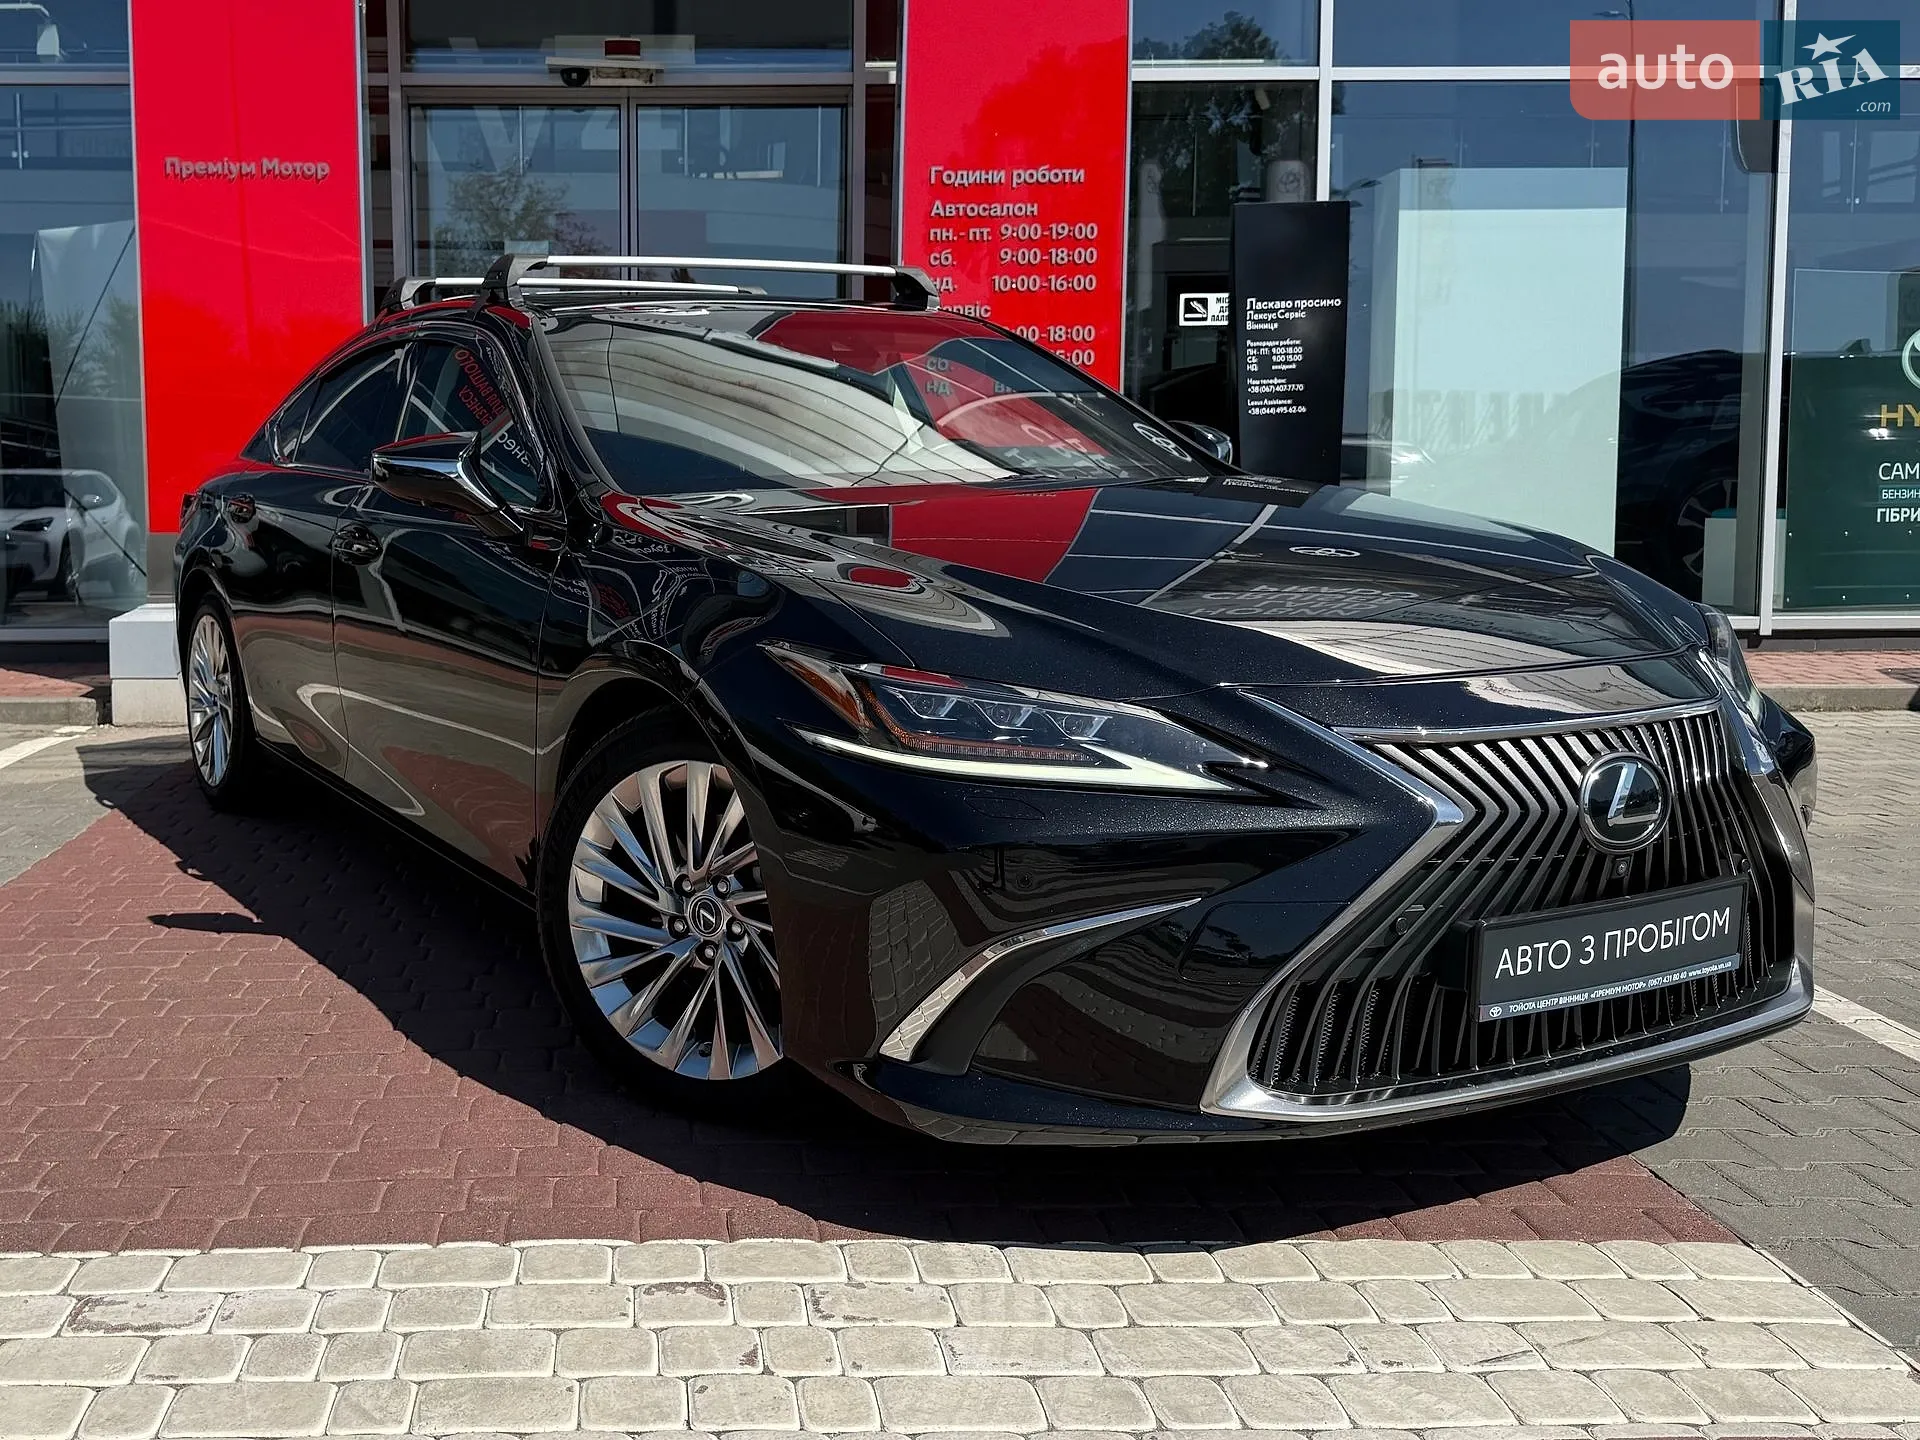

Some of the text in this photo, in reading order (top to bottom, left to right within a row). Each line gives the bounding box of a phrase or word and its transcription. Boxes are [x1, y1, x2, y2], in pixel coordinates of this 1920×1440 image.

[164, 157, 330, 180] Преміум Мотор
[929, 164, 1085, 188] Години роботи
[930, 200, 1038, 218] Автосалон
[1000, 223, 1098, 240] 9:00-19:00
[929, 248, 1097, 266] сб. 9:00-18:00
[992, 275, 1097, 292] 10:00-16:00
[1246, 298, 1342, 311] Ласкаво просимо
[1246, 309, 1306, 322] Лексус Сервіс
[1003, 325, 1096, 342] :00-18:00
[1246, 320, 1279, 332] Вінниця
[1494, 939, 1572, 980] АВТО
[1603, 906, 1731, 961] ПРОБІГОМ
[1508, 1002, 1537, 1014] ТОЙОТА
[1536, 998, 1558, 1009] ЦЕНТР
